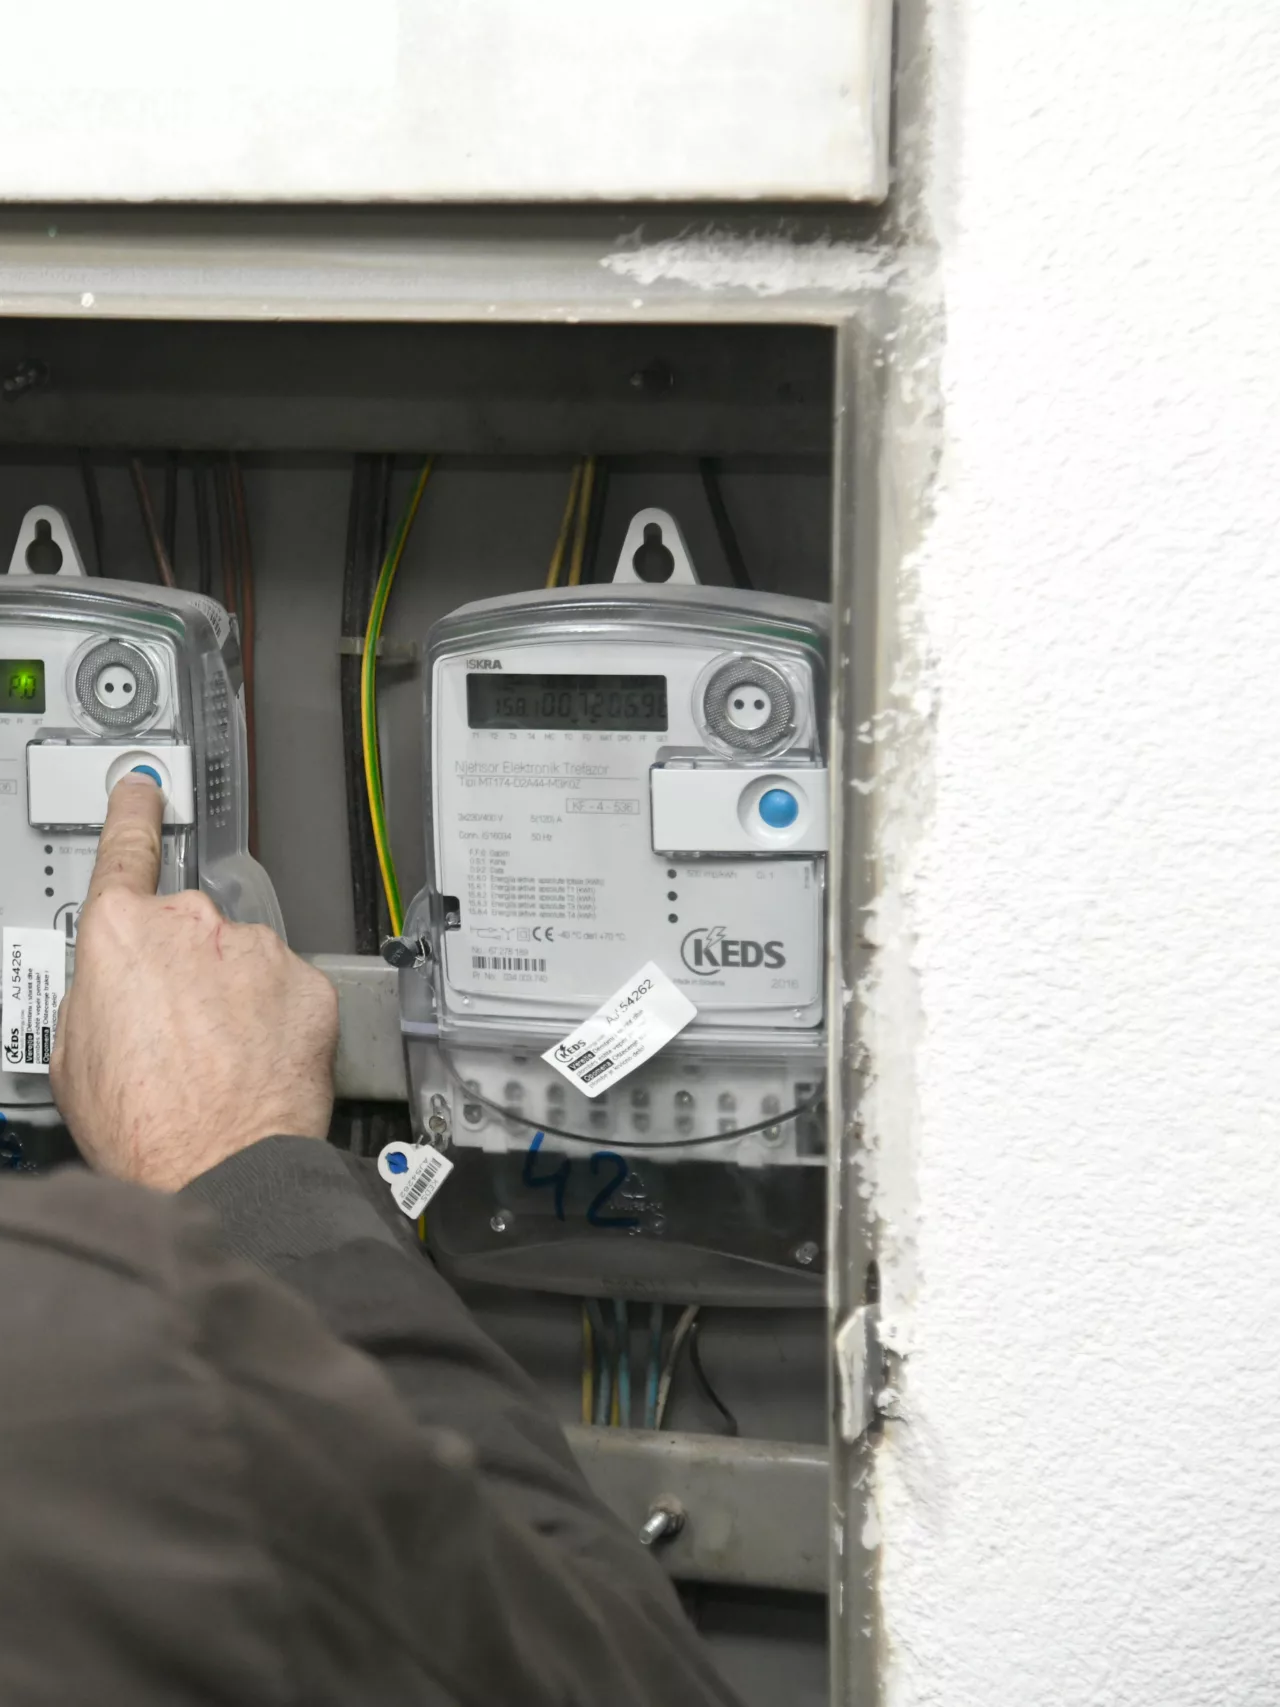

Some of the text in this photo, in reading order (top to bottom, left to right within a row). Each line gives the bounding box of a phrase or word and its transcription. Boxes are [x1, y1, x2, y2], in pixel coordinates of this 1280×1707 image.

[466, 659, 502, 670] ISKRA
[455, 760, 610, 779] Njehsor Elektronik Trefazor
[572, 801, 585, 811] KF
[532, 926, 554, 942] CE
[688, 933, 786, 972] KEDS
[11, 944, 22, 1001] AJ 54261
[620, 979, 655, 1014] 54262
[7, 1028, 20, 1061] KEDS
[42, 1029, 50, 1063] Opomena
[557, 1039, 587, 1060] KEDS
[583, 1061, 613, 1083] Opomena
[421, 1179, 439, 1202] KEDS
[523, 1131, 640, 1228] 42
